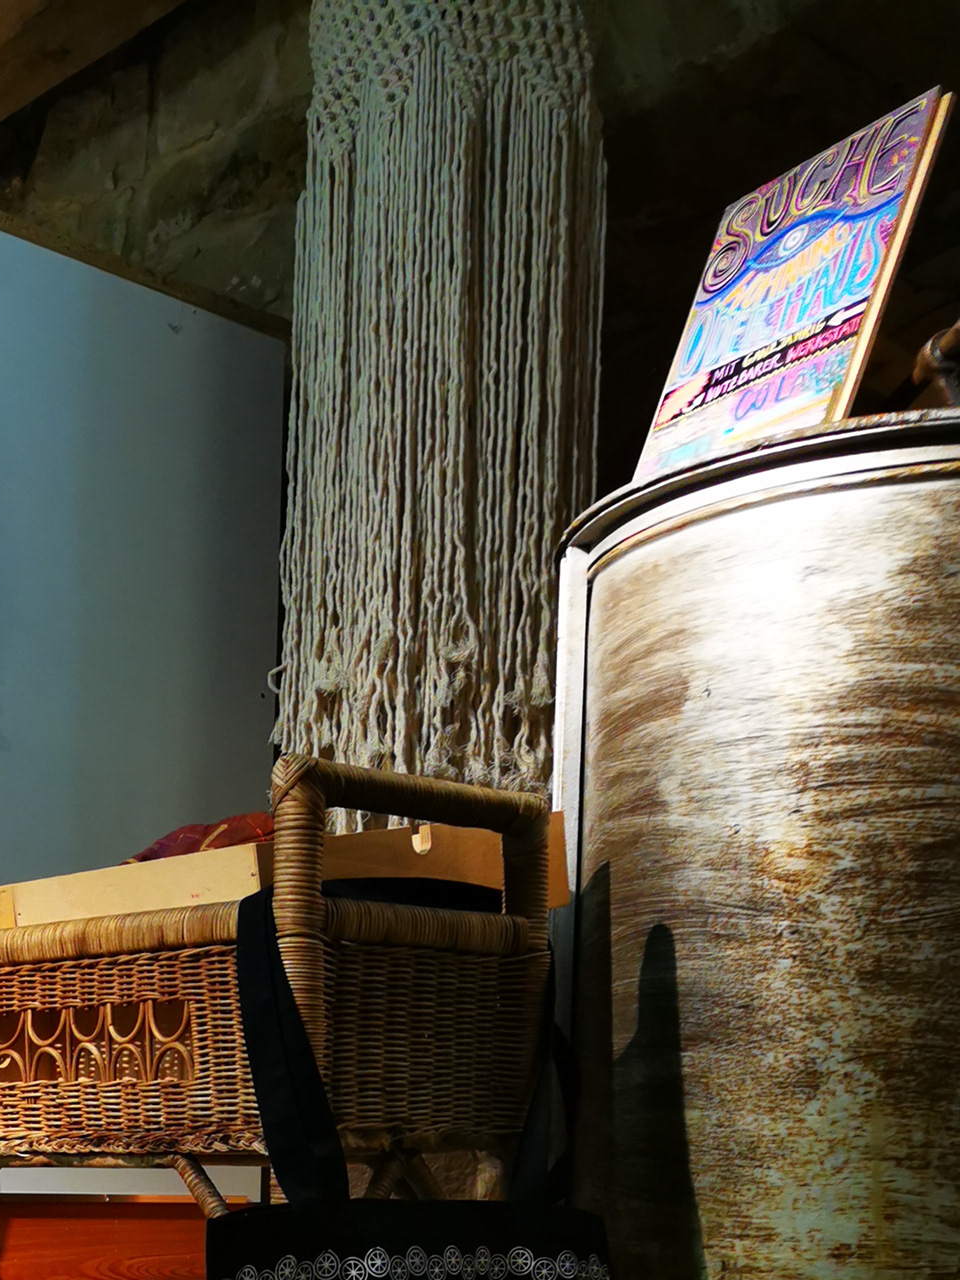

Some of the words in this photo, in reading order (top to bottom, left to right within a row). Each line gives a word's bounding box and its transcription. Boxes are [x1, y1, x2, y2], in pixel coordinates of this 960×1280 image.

[702, 100, 927, 293] SUCHE
[721, 219, 853, 312] WOHNUNG
[777, 205, 898, 333] HAUS
[713, 359, 741, 384] MIT
